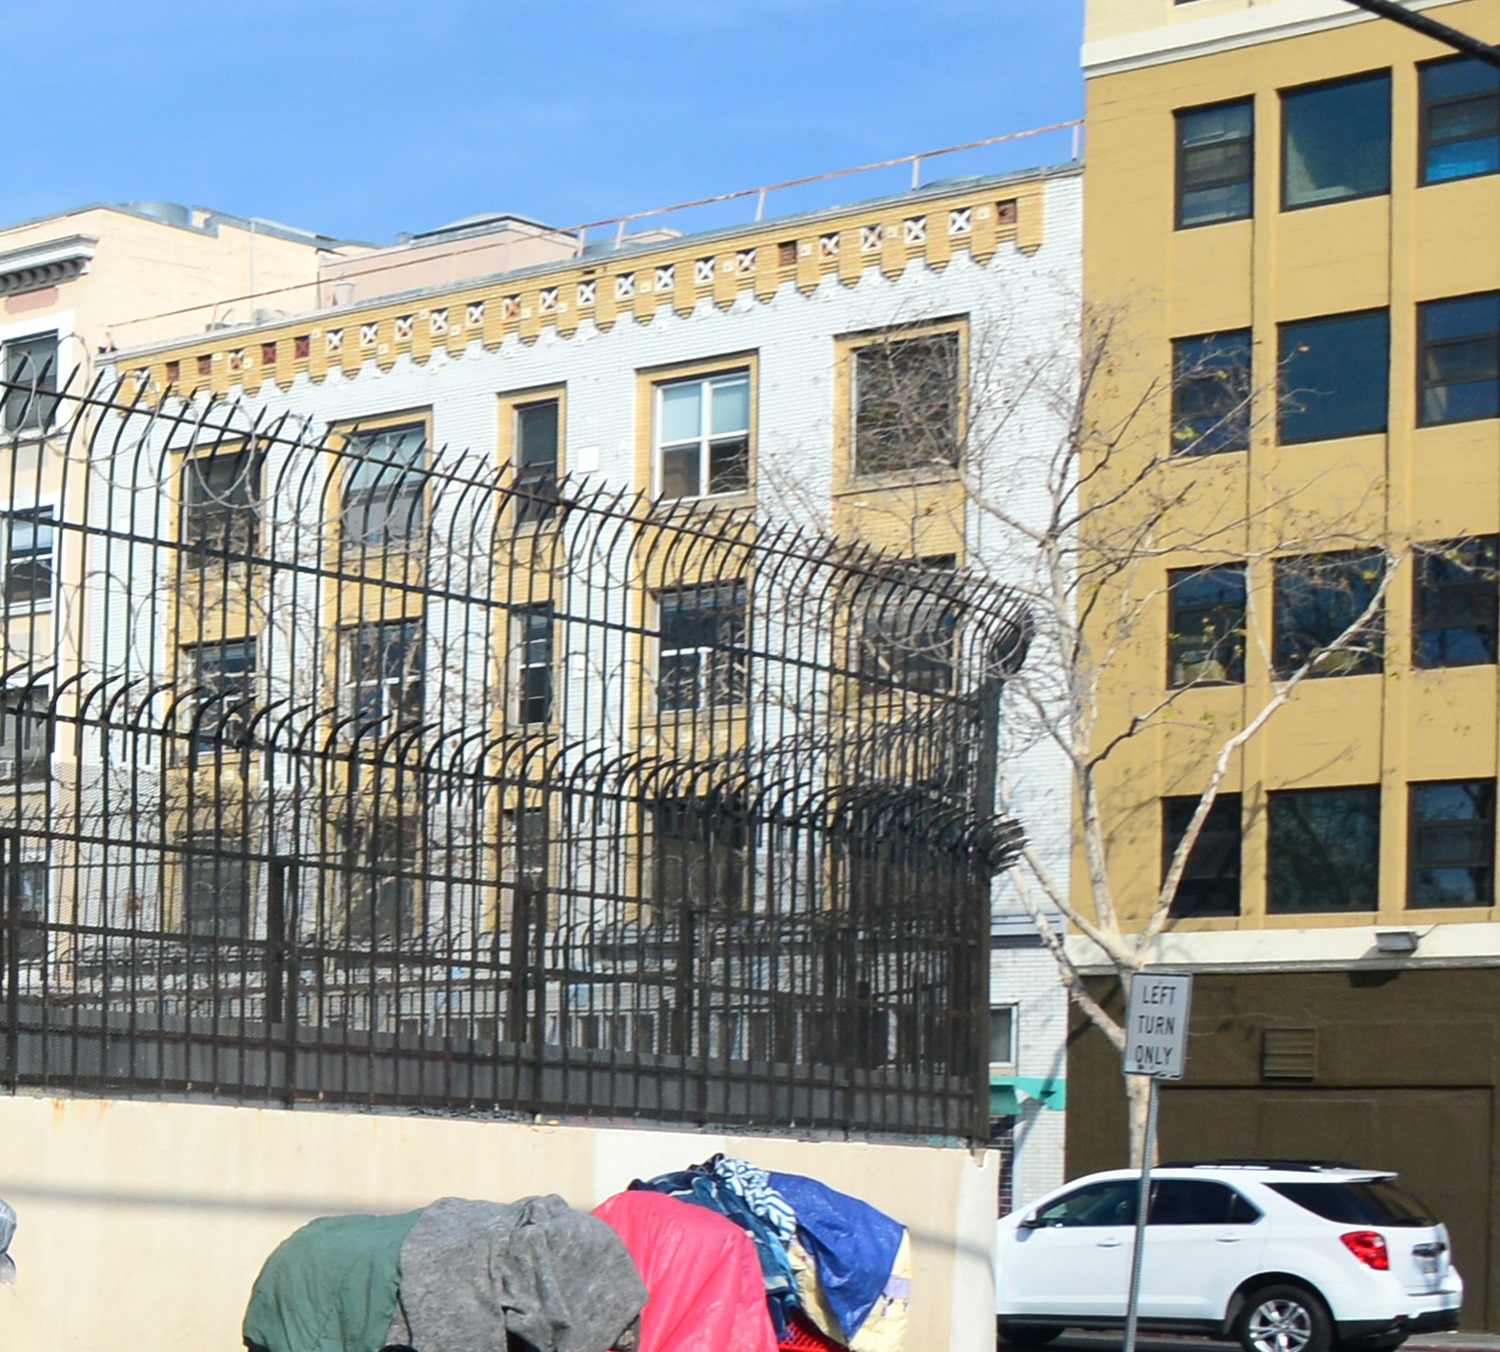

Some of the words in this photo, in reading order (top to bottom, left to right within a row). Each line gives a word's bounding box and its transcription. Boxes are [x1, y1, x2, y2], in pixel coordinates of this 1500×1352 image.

[1142, 985, 1176, 1005] LEFT
[1138, 1015, 1175, 1035] TURN
[1135, 1045, 1173, 1065] ONLY
